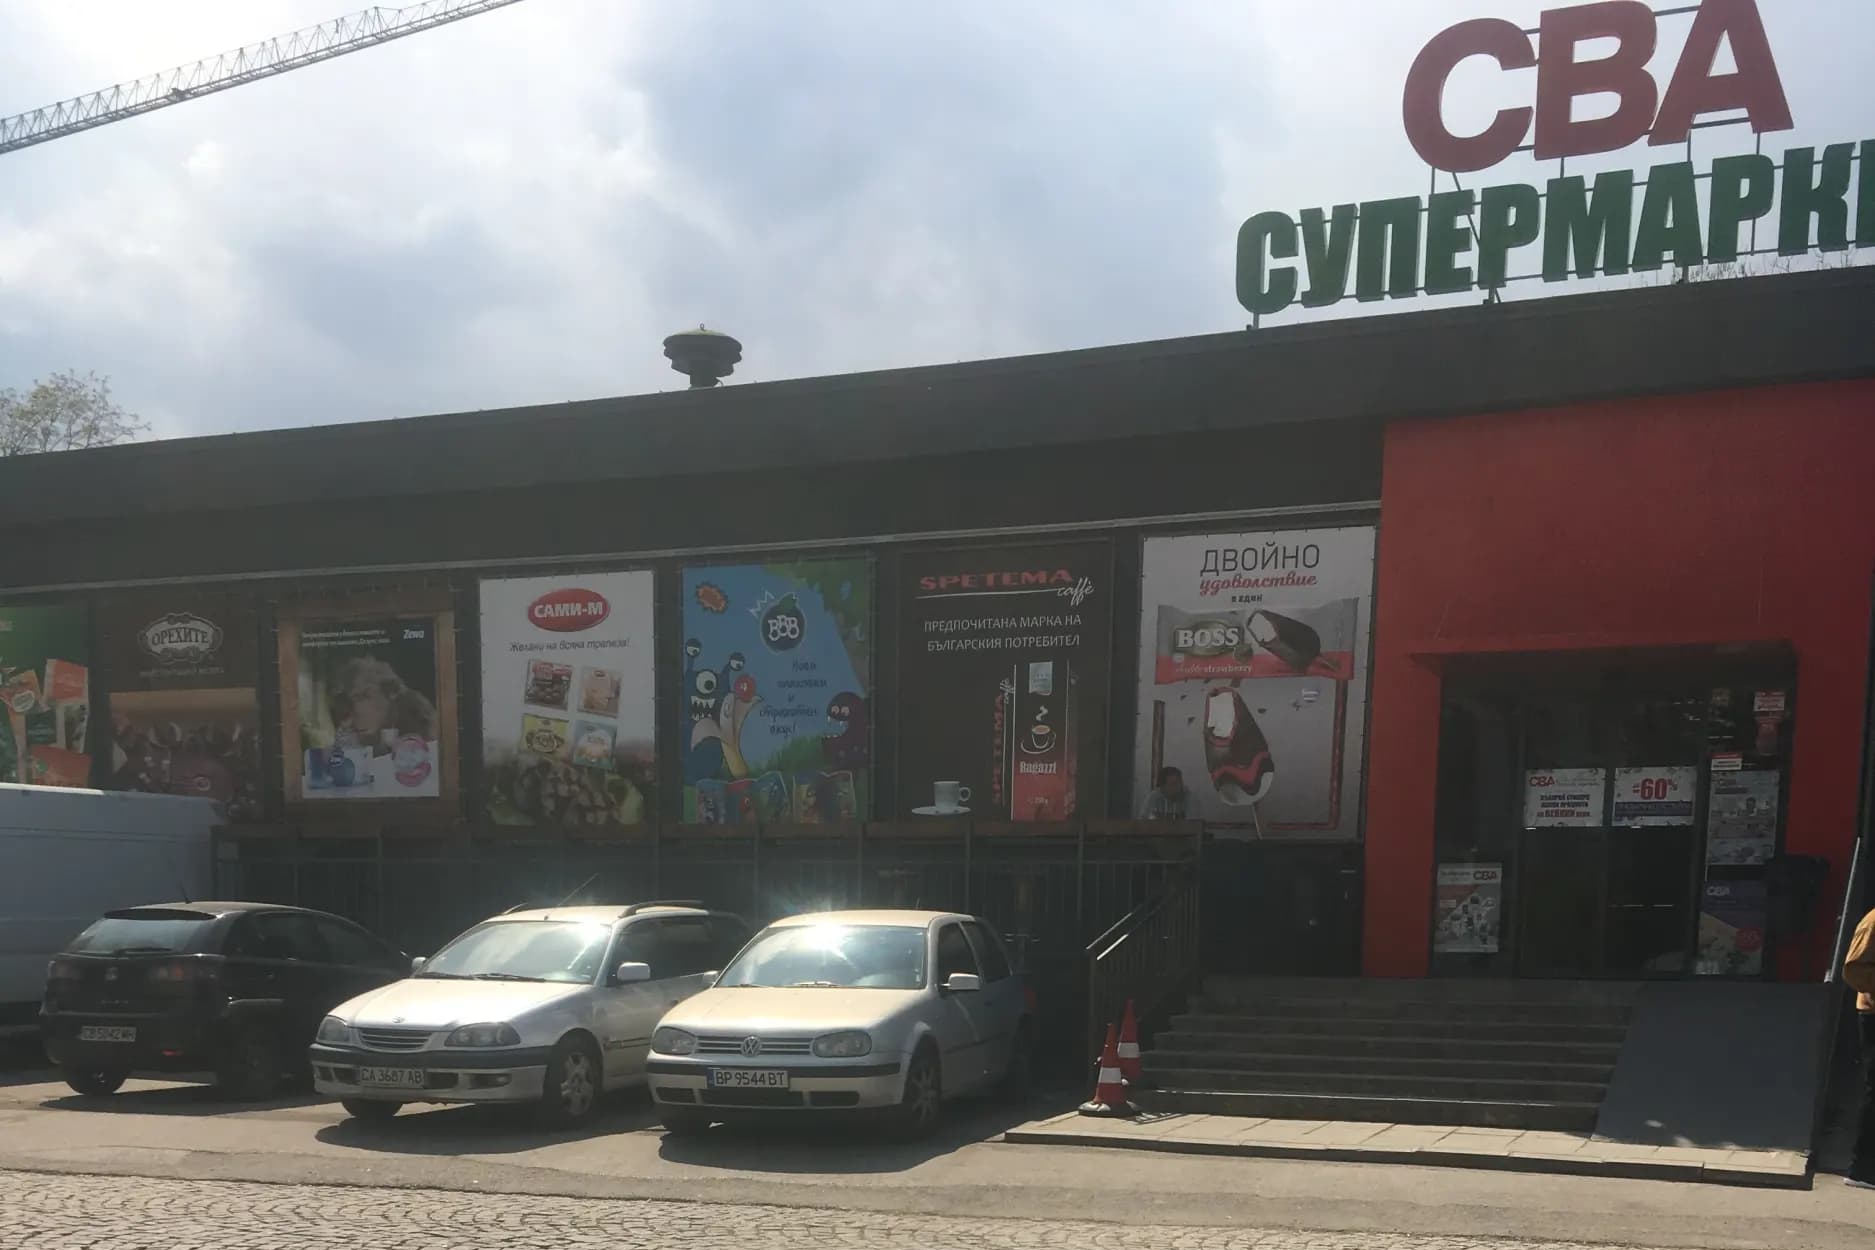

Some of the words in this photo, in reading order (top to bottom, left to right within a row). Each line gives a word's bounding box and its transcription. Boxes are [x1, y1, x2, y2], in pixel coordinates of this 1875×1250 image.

[1403, 0, 1794, 173] CBA
[1200, 541, 1320, 576] ДВОЙНО
[919, 568, 1073, 590] SPETEMA
[1200, 571, 1317, 596] удоволствие
[534, 601, 603, 617] САМИ-М
[924, 616, 1017, 633] ПРЕДПОЧИТАНА
[1020, 615, 1063, 628] МАРКА
[1065, 613, 1082, 626] НА
[152, 627, 208, 645] ОРЕХИТЕ
[927, 638, 1002, 652] БЪЛГАРСКИЯ
[1004, 634, 1080, 649] ПОТРЕБИТЕЛ
[1176, 627, 1239, 648] BOSS
[362, 1068, 375, 1081] CA
[716, 1071, 732, 1085] BP
[734, 1071, 766, 1086] 9544
[768, 1072, 785, 1086] BT
